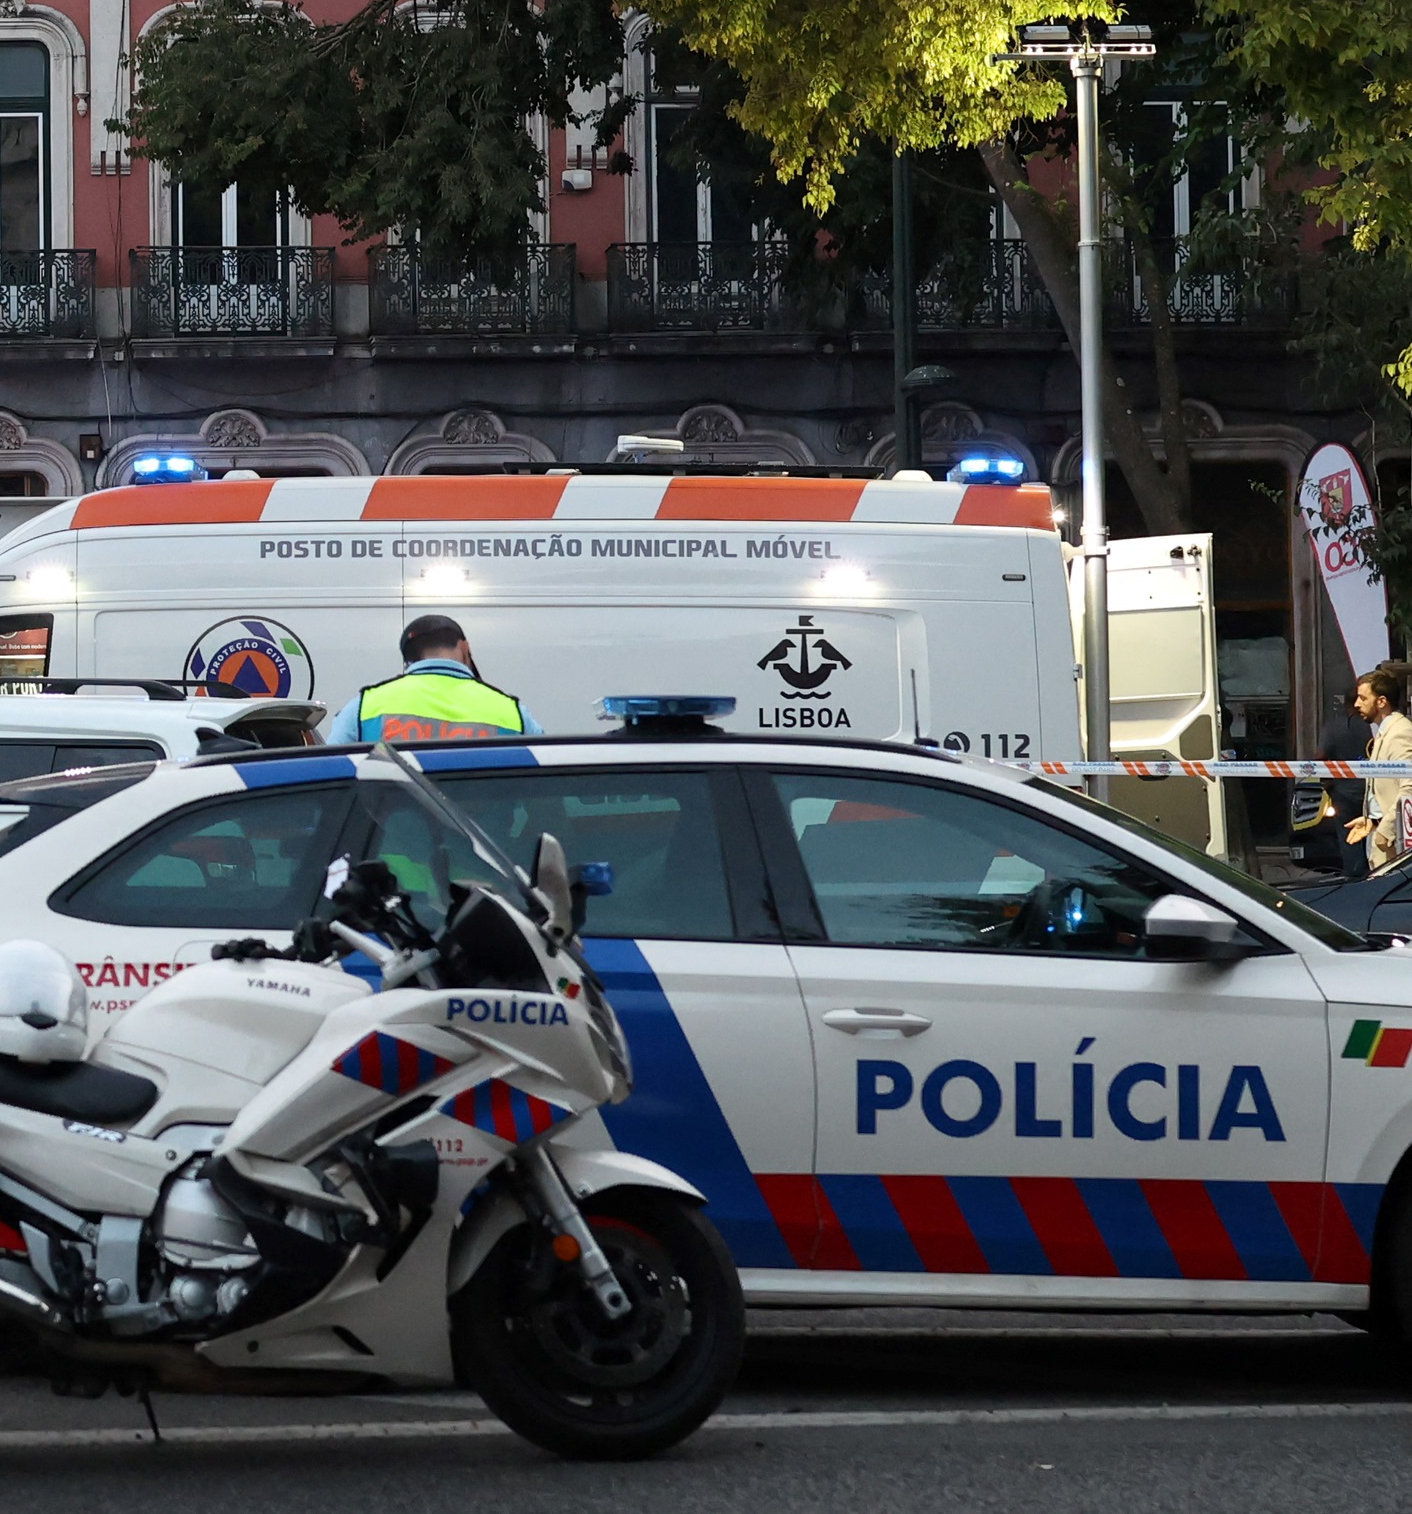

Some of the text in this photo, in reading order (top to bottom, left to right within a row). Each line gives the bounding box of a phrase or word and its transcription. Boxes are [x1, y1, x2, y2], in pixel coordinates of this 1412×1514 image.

[260, 534, 841, 560] POSTO DE COORDENAÇÃO MUNICIPAL MÓVEL
[210, 640, 287, 675] PROTEÇÃO CIVIL
[759, 707, 851, 728] LISBOA
[981, 734, 1030, 758] 112
[76, 956, 196, 987] RÂNS
[247, 978, 311, 997] YAMAHA
[856, 1037, 1286, 1142] POLÍCIA
